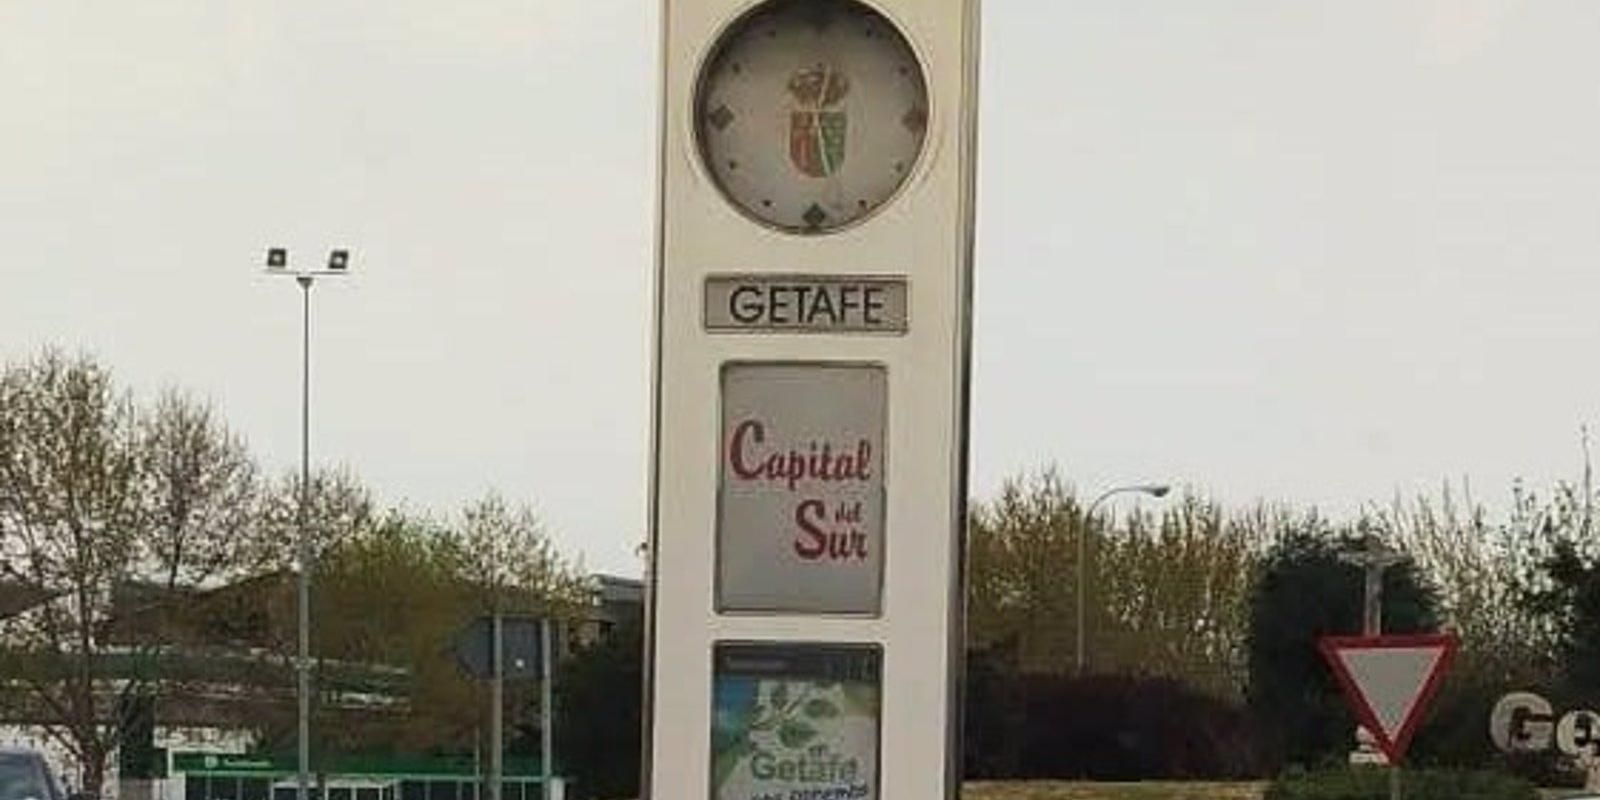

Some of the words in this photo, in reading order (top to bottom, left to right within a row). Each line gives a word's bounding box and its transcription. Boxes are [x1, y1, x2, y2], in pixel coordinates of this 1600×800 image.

[729, 285, 883, 325] GETAFE
[729, 419, 872, 491] Capital
[794, 499, 868, 560] Sur
[834, 501, 862, 523] del
